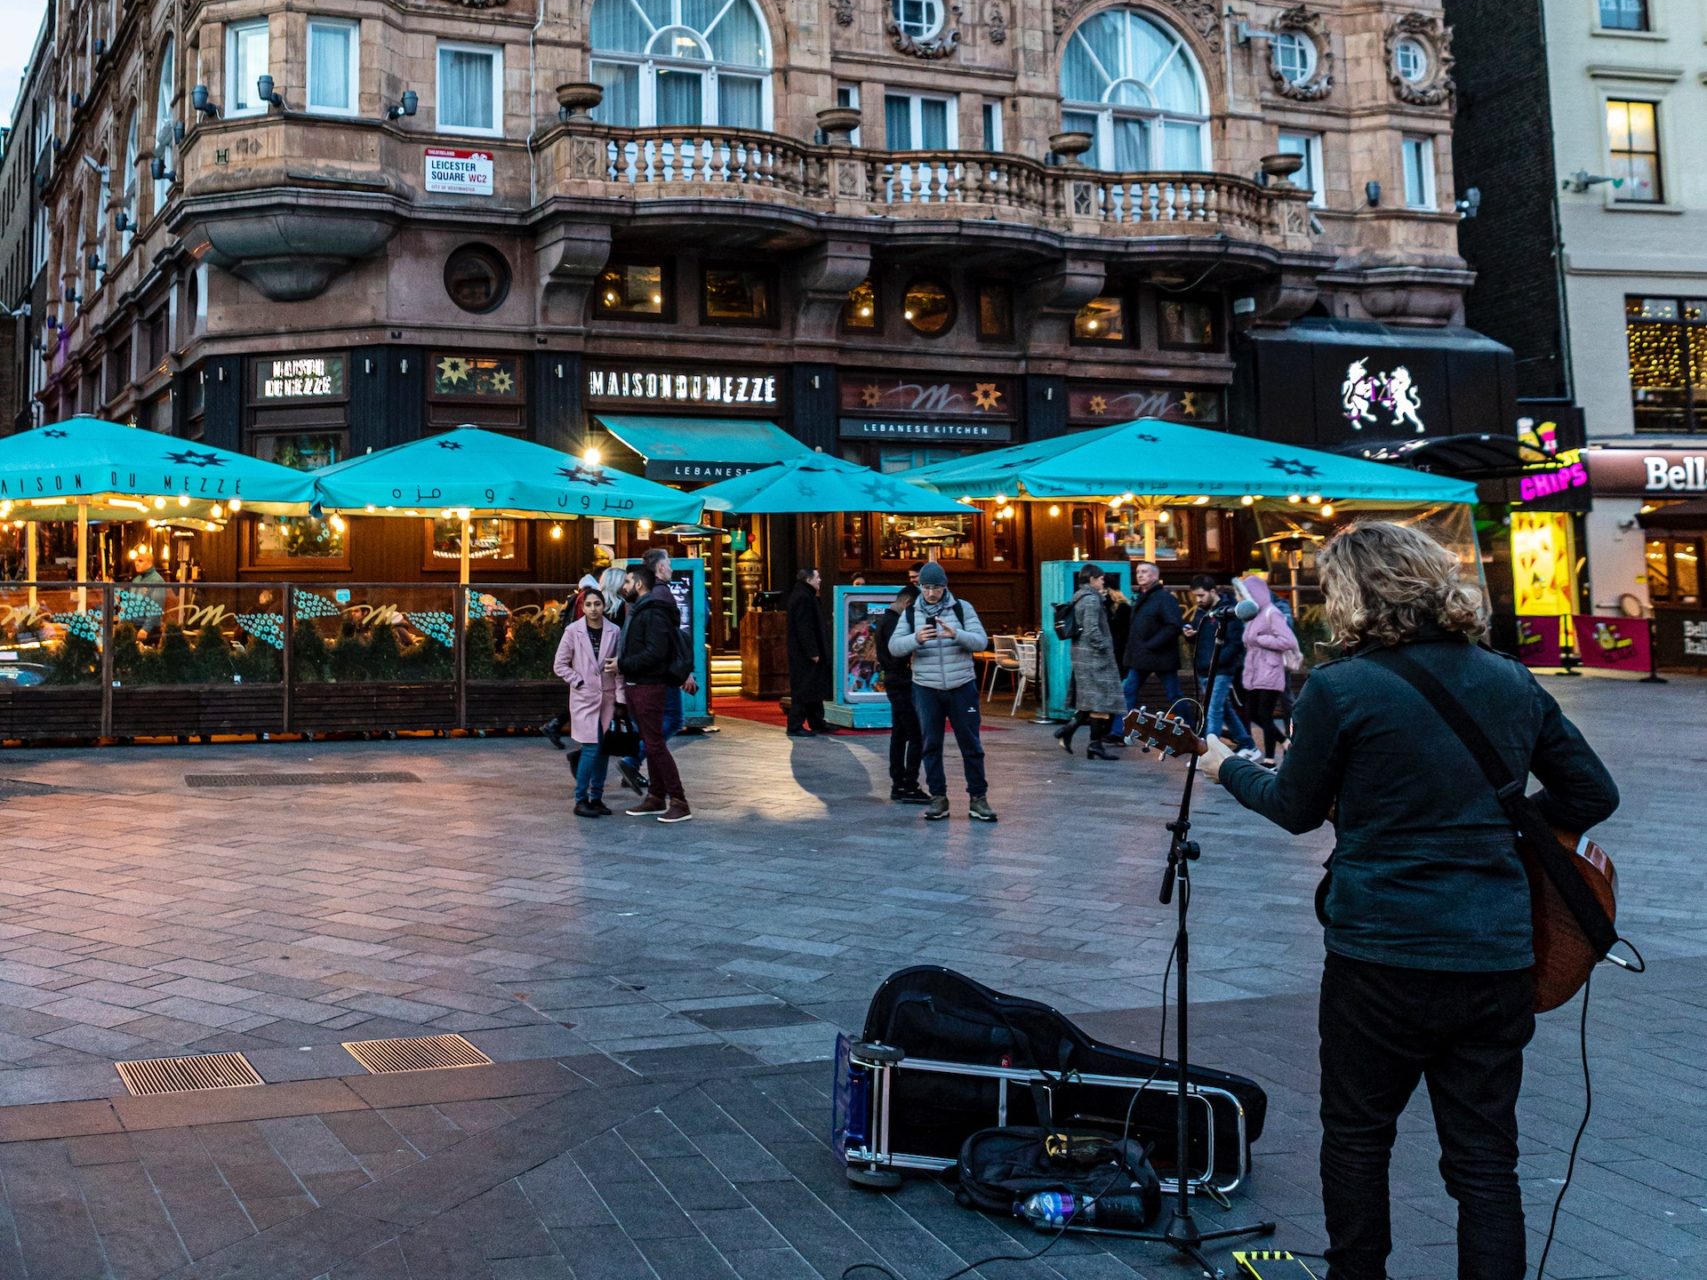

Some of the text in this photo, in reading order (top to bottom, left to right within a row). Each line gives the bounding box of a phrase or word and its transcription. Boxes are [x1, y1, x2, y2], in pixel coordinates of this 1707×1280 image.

[431, 160, 476, 172] LEICESTER
[431, 170, 487, 184] SQUARE WC2
[863, 423, 988, 435] LEBANESE KITCHEN
[111, 471, 136, 488] DU
[1520, 462, 1588, 501] CHIPS
